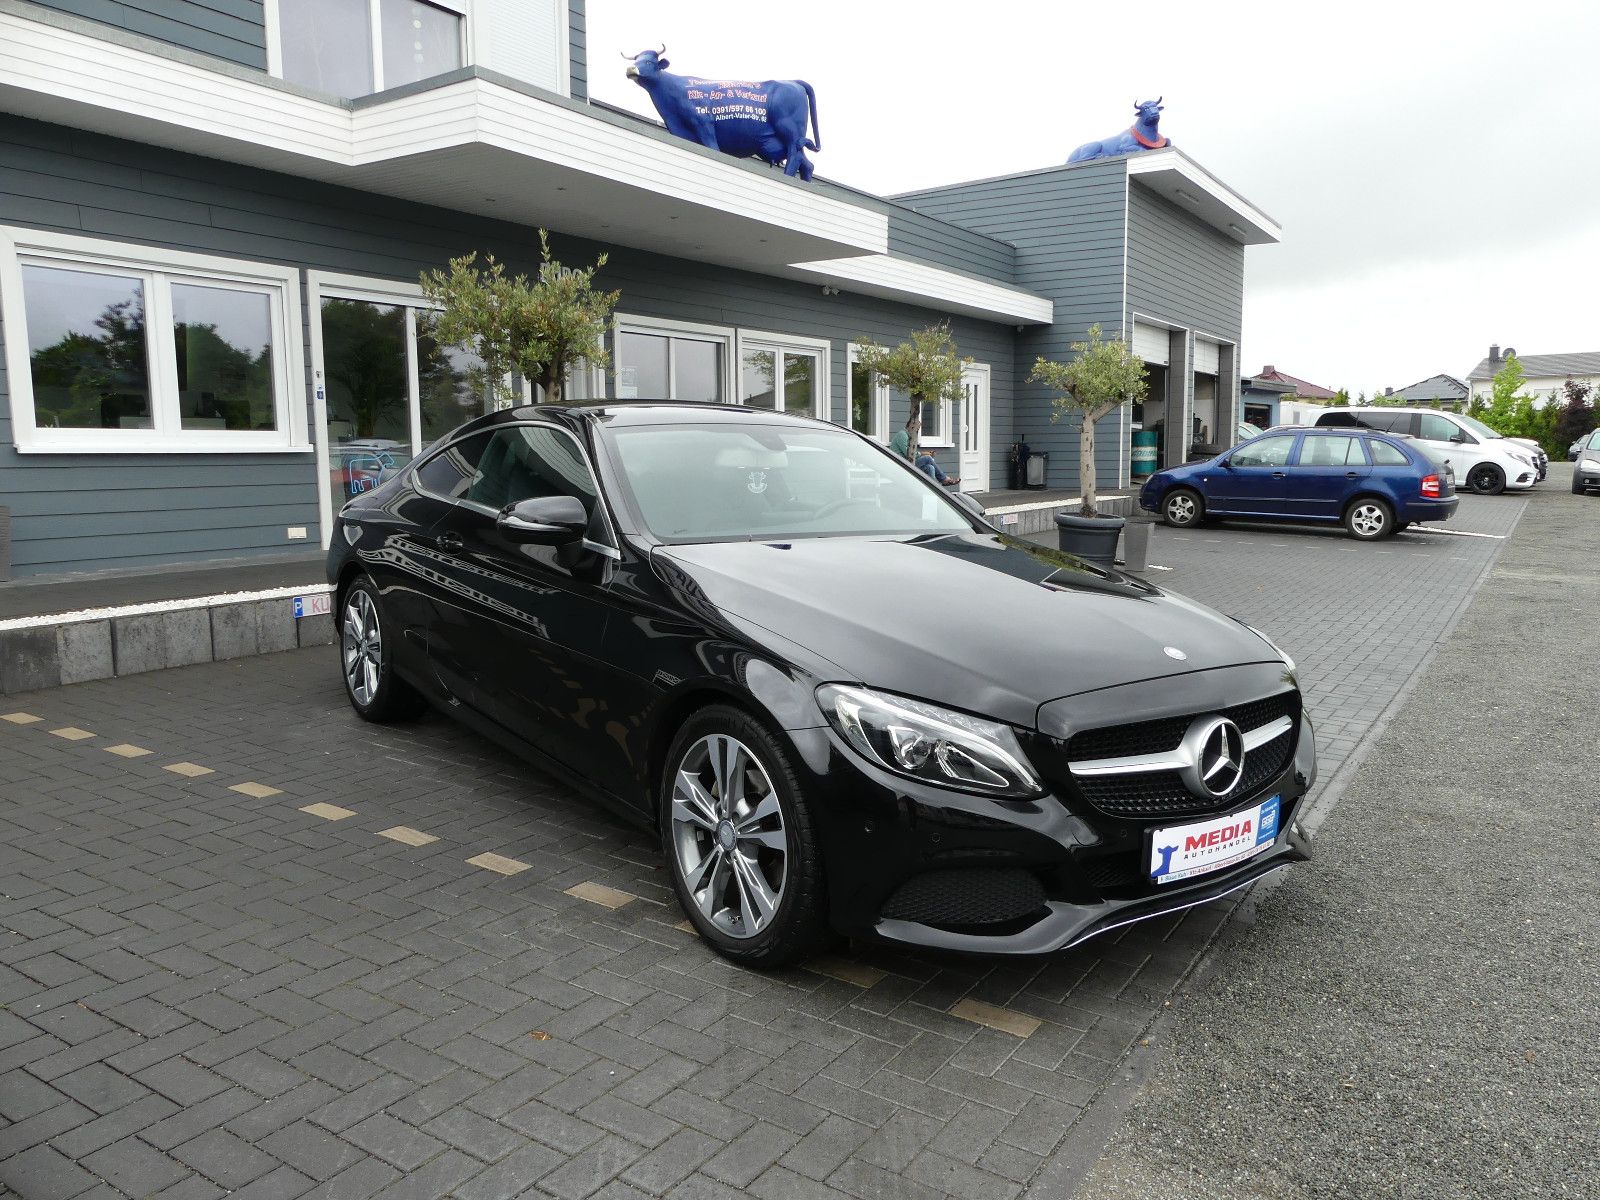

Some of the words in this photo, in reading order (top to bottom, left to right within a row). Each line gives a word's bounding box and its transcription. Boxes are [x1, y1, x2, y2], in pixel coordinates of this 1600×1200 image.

[696, 106, 709, 114] Tel.
[294, 601, 302, 614] P
[1184, 819, 1252, 852] MEDIA
[1183, 836, 1251, 860] AUTOHANDEL
